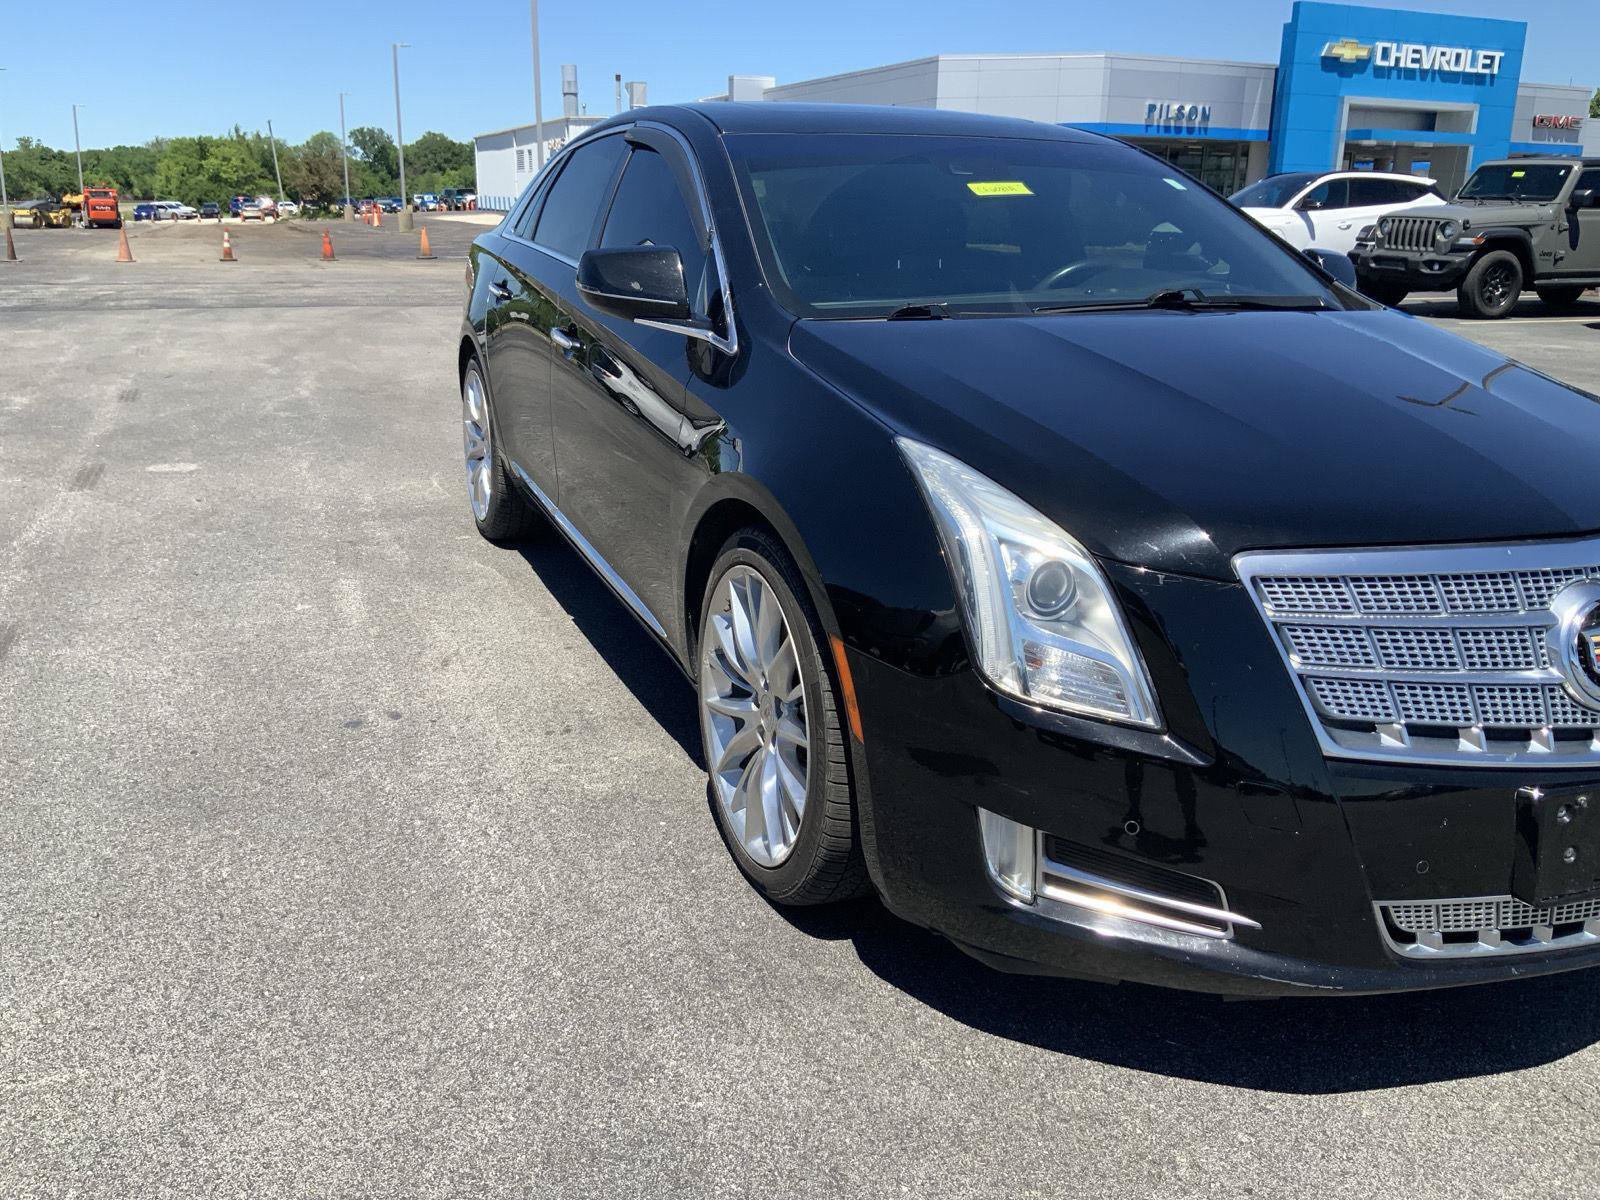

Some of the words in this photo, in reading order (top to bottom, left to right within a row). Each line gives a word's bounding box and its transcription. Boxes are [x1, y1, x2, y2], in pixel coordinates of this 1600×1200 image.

[1375, 42, 1504, 75] CHEVROLET
[1146, 102, 1211, 121] PILSON
[1533, 114, 1585, 128] GMC
